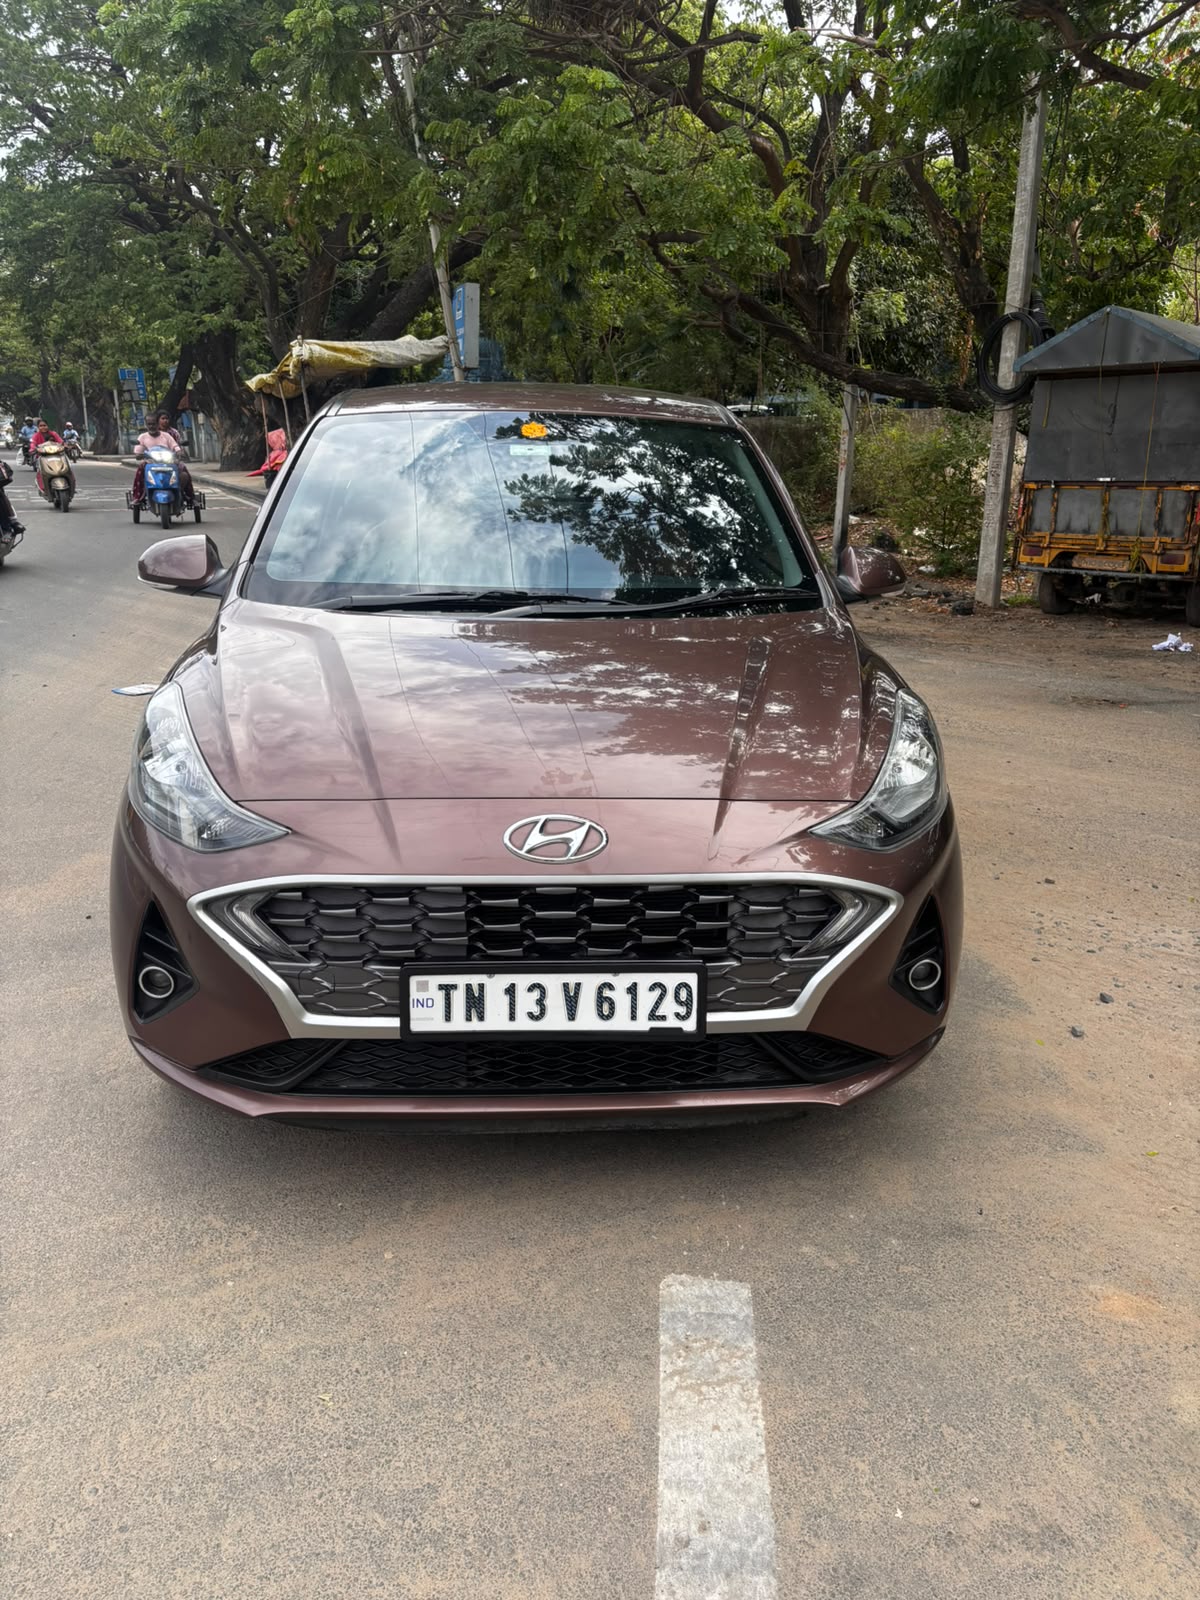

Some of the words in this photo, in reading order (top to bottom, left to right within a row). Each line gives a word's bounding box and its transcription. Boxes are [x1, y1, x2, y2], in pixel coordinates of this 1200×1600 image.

[412, 998, 434, 1008] IND
[438, 983, 485, 1022] TN
[504, 982, 547, 1022] 13
[562, 982, 582, 1022] V
[596, 981, 694, 1022] 6129
